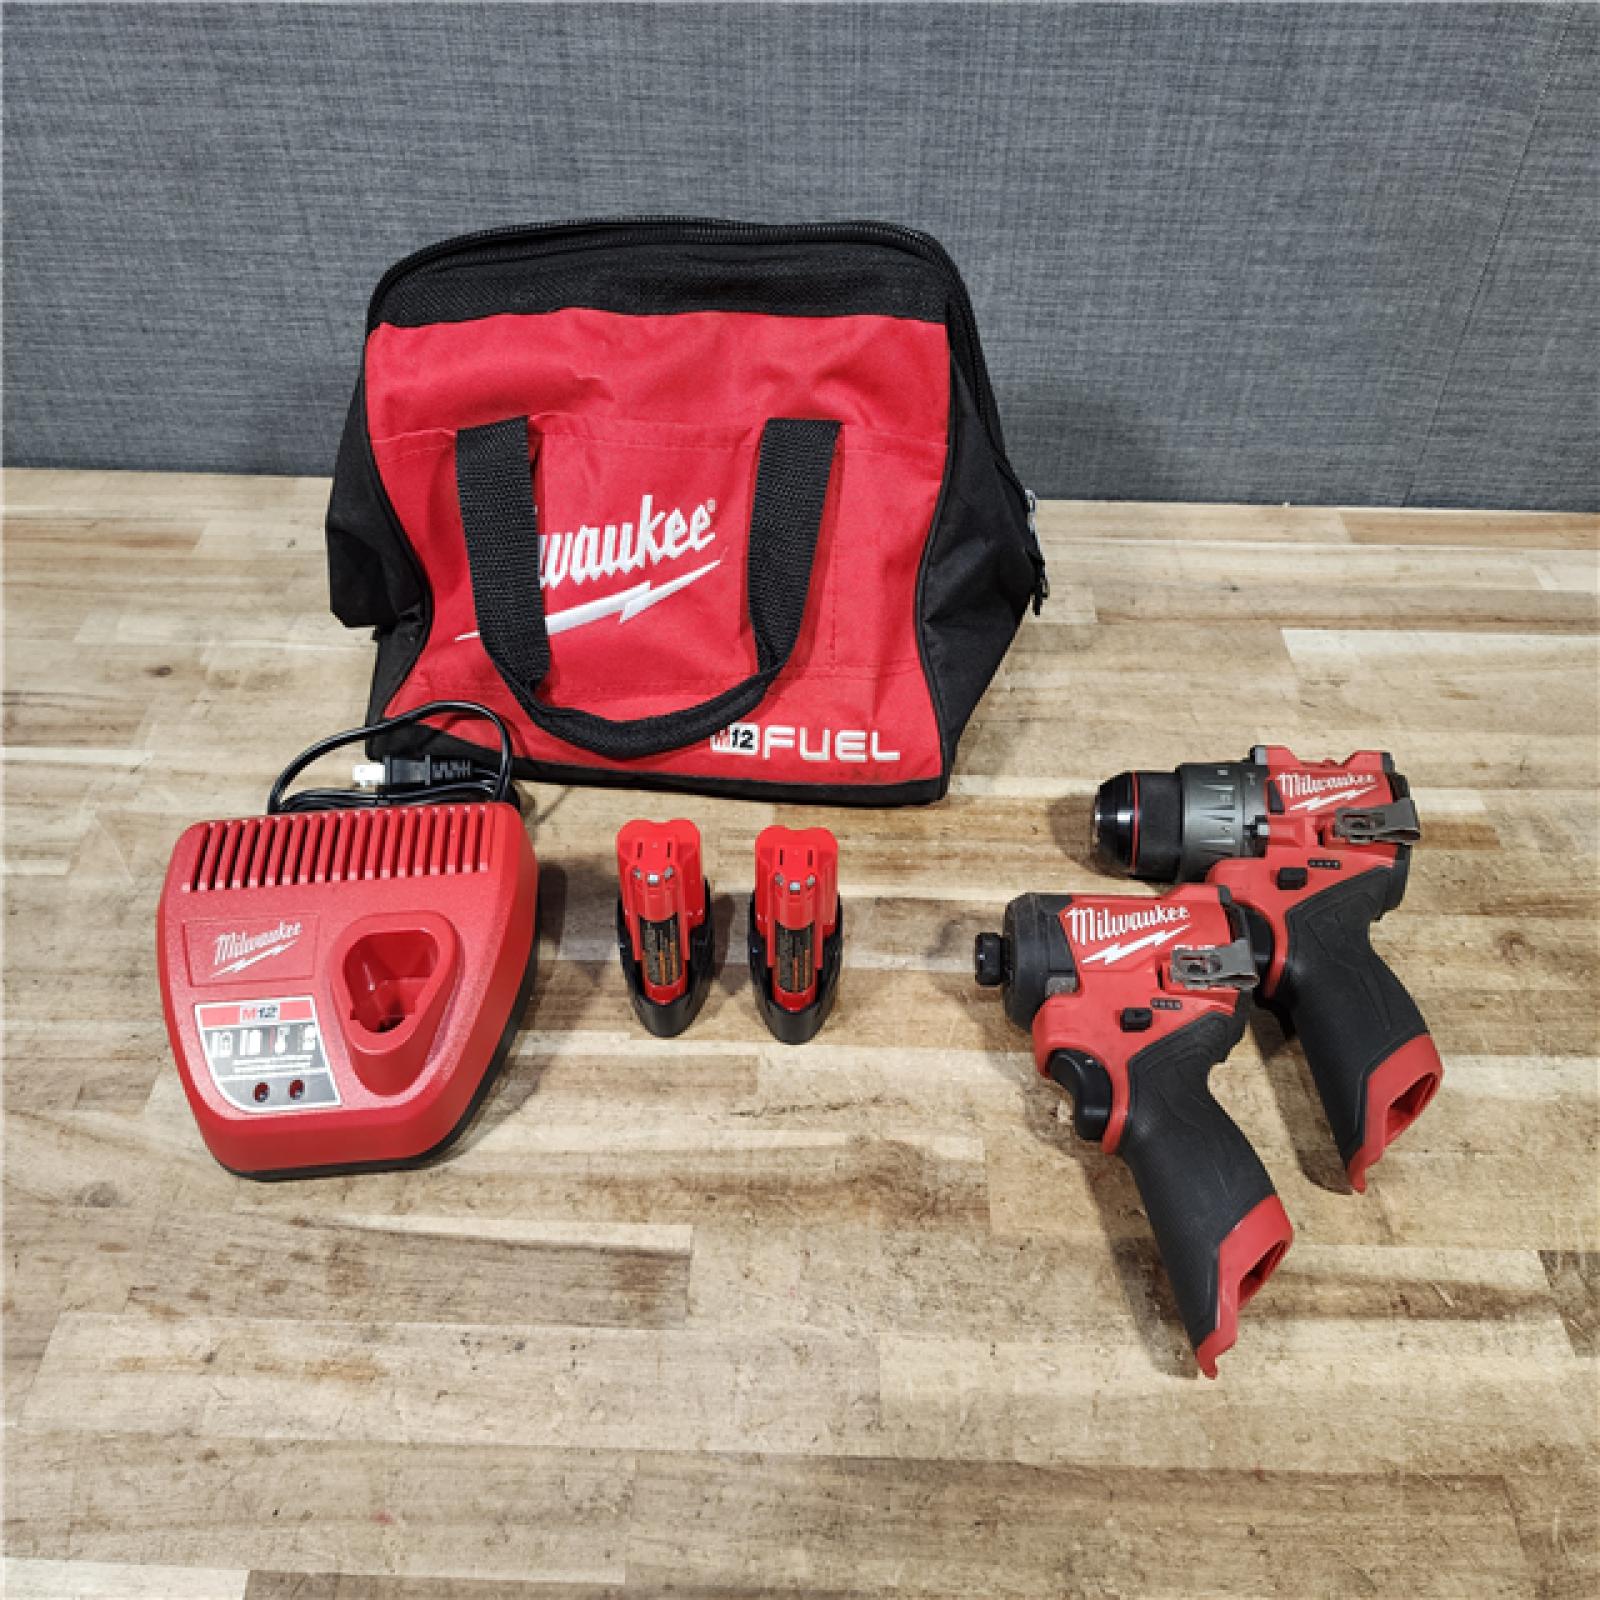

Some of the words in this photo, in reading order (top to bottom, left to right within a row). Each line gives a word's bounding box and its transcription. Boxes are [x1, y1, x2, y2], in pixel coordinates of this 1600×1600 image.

[538, 494, 716, 589] waukee
[763, 726, 900, 761] FUEL
[1065, 905, 1190, 945] Milwaukee
